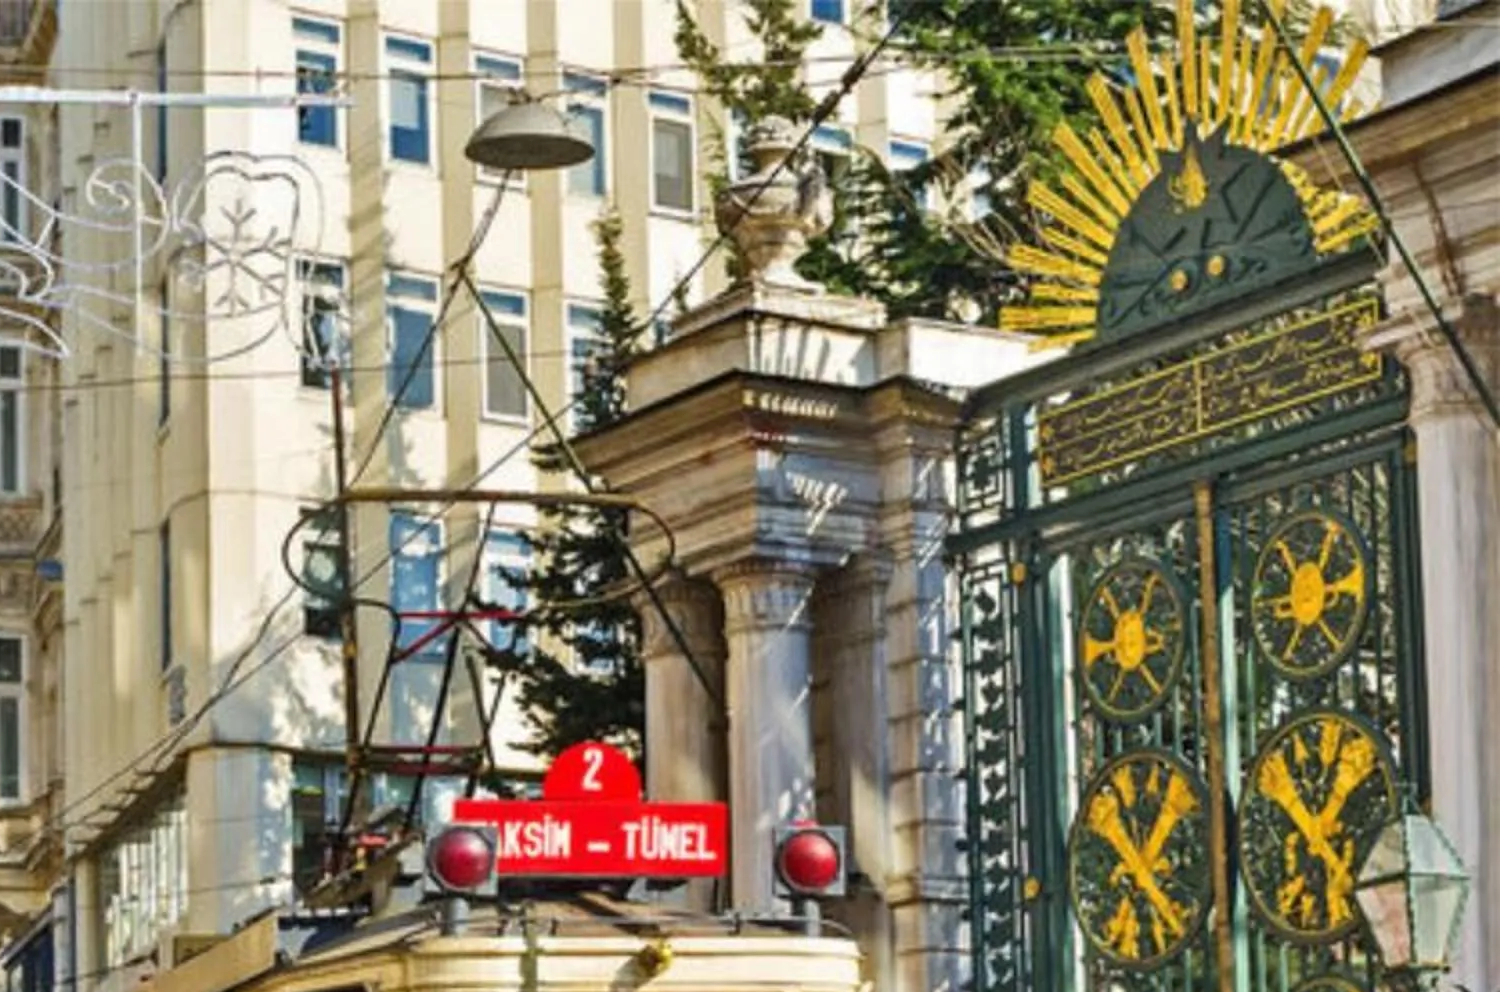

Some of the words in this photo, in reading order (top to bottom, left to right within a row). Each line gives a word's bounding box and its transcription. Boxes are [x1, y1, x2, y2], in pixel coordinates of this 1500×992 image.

[581, 748, 604, 791] 2
[497, 815, 572, 858] KSİM
[621, 816, 716, 860] TÜNEL
